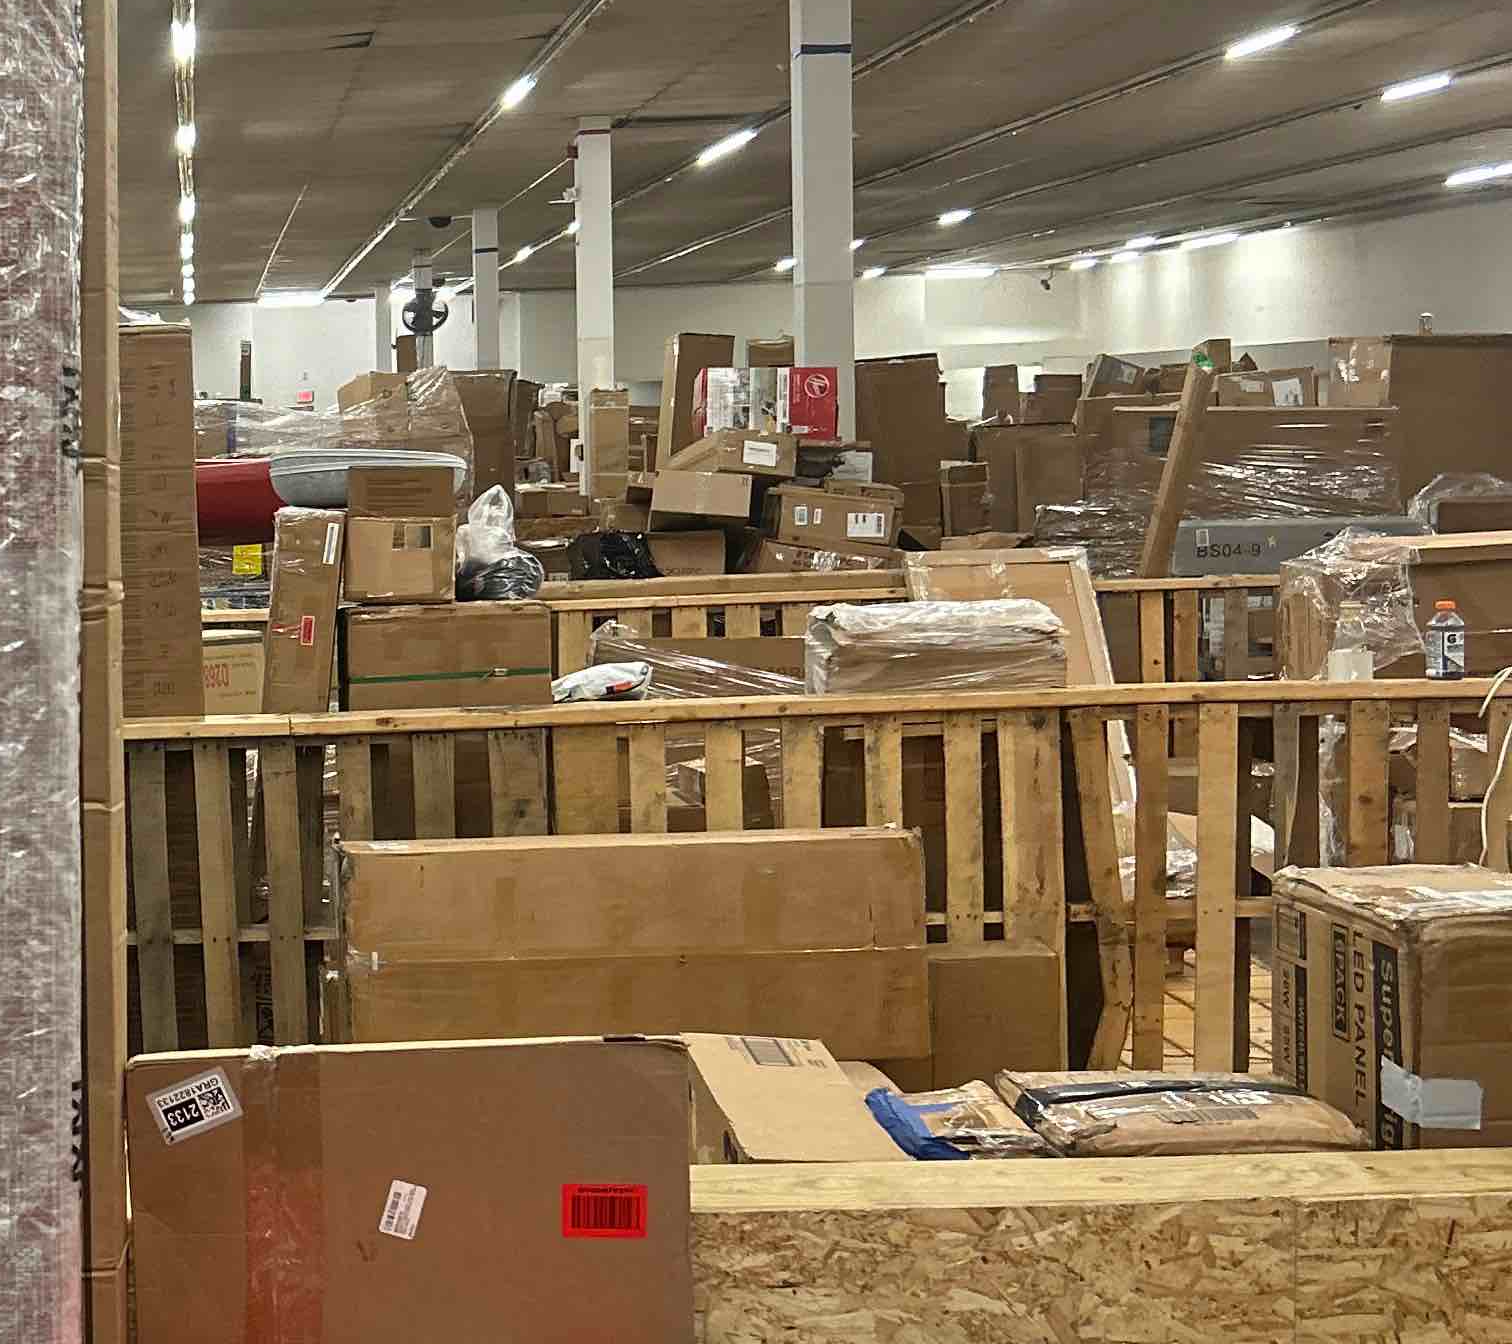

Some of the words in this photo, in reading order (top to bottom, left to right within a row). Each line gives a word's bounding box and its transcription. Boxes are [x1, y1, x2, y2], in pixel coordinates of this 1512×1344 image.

[1352, 930, 1366, 992] LED
[1353, 1002, 1368, 1105] PANEL
[167, 1102, 201, 1127] 2133
